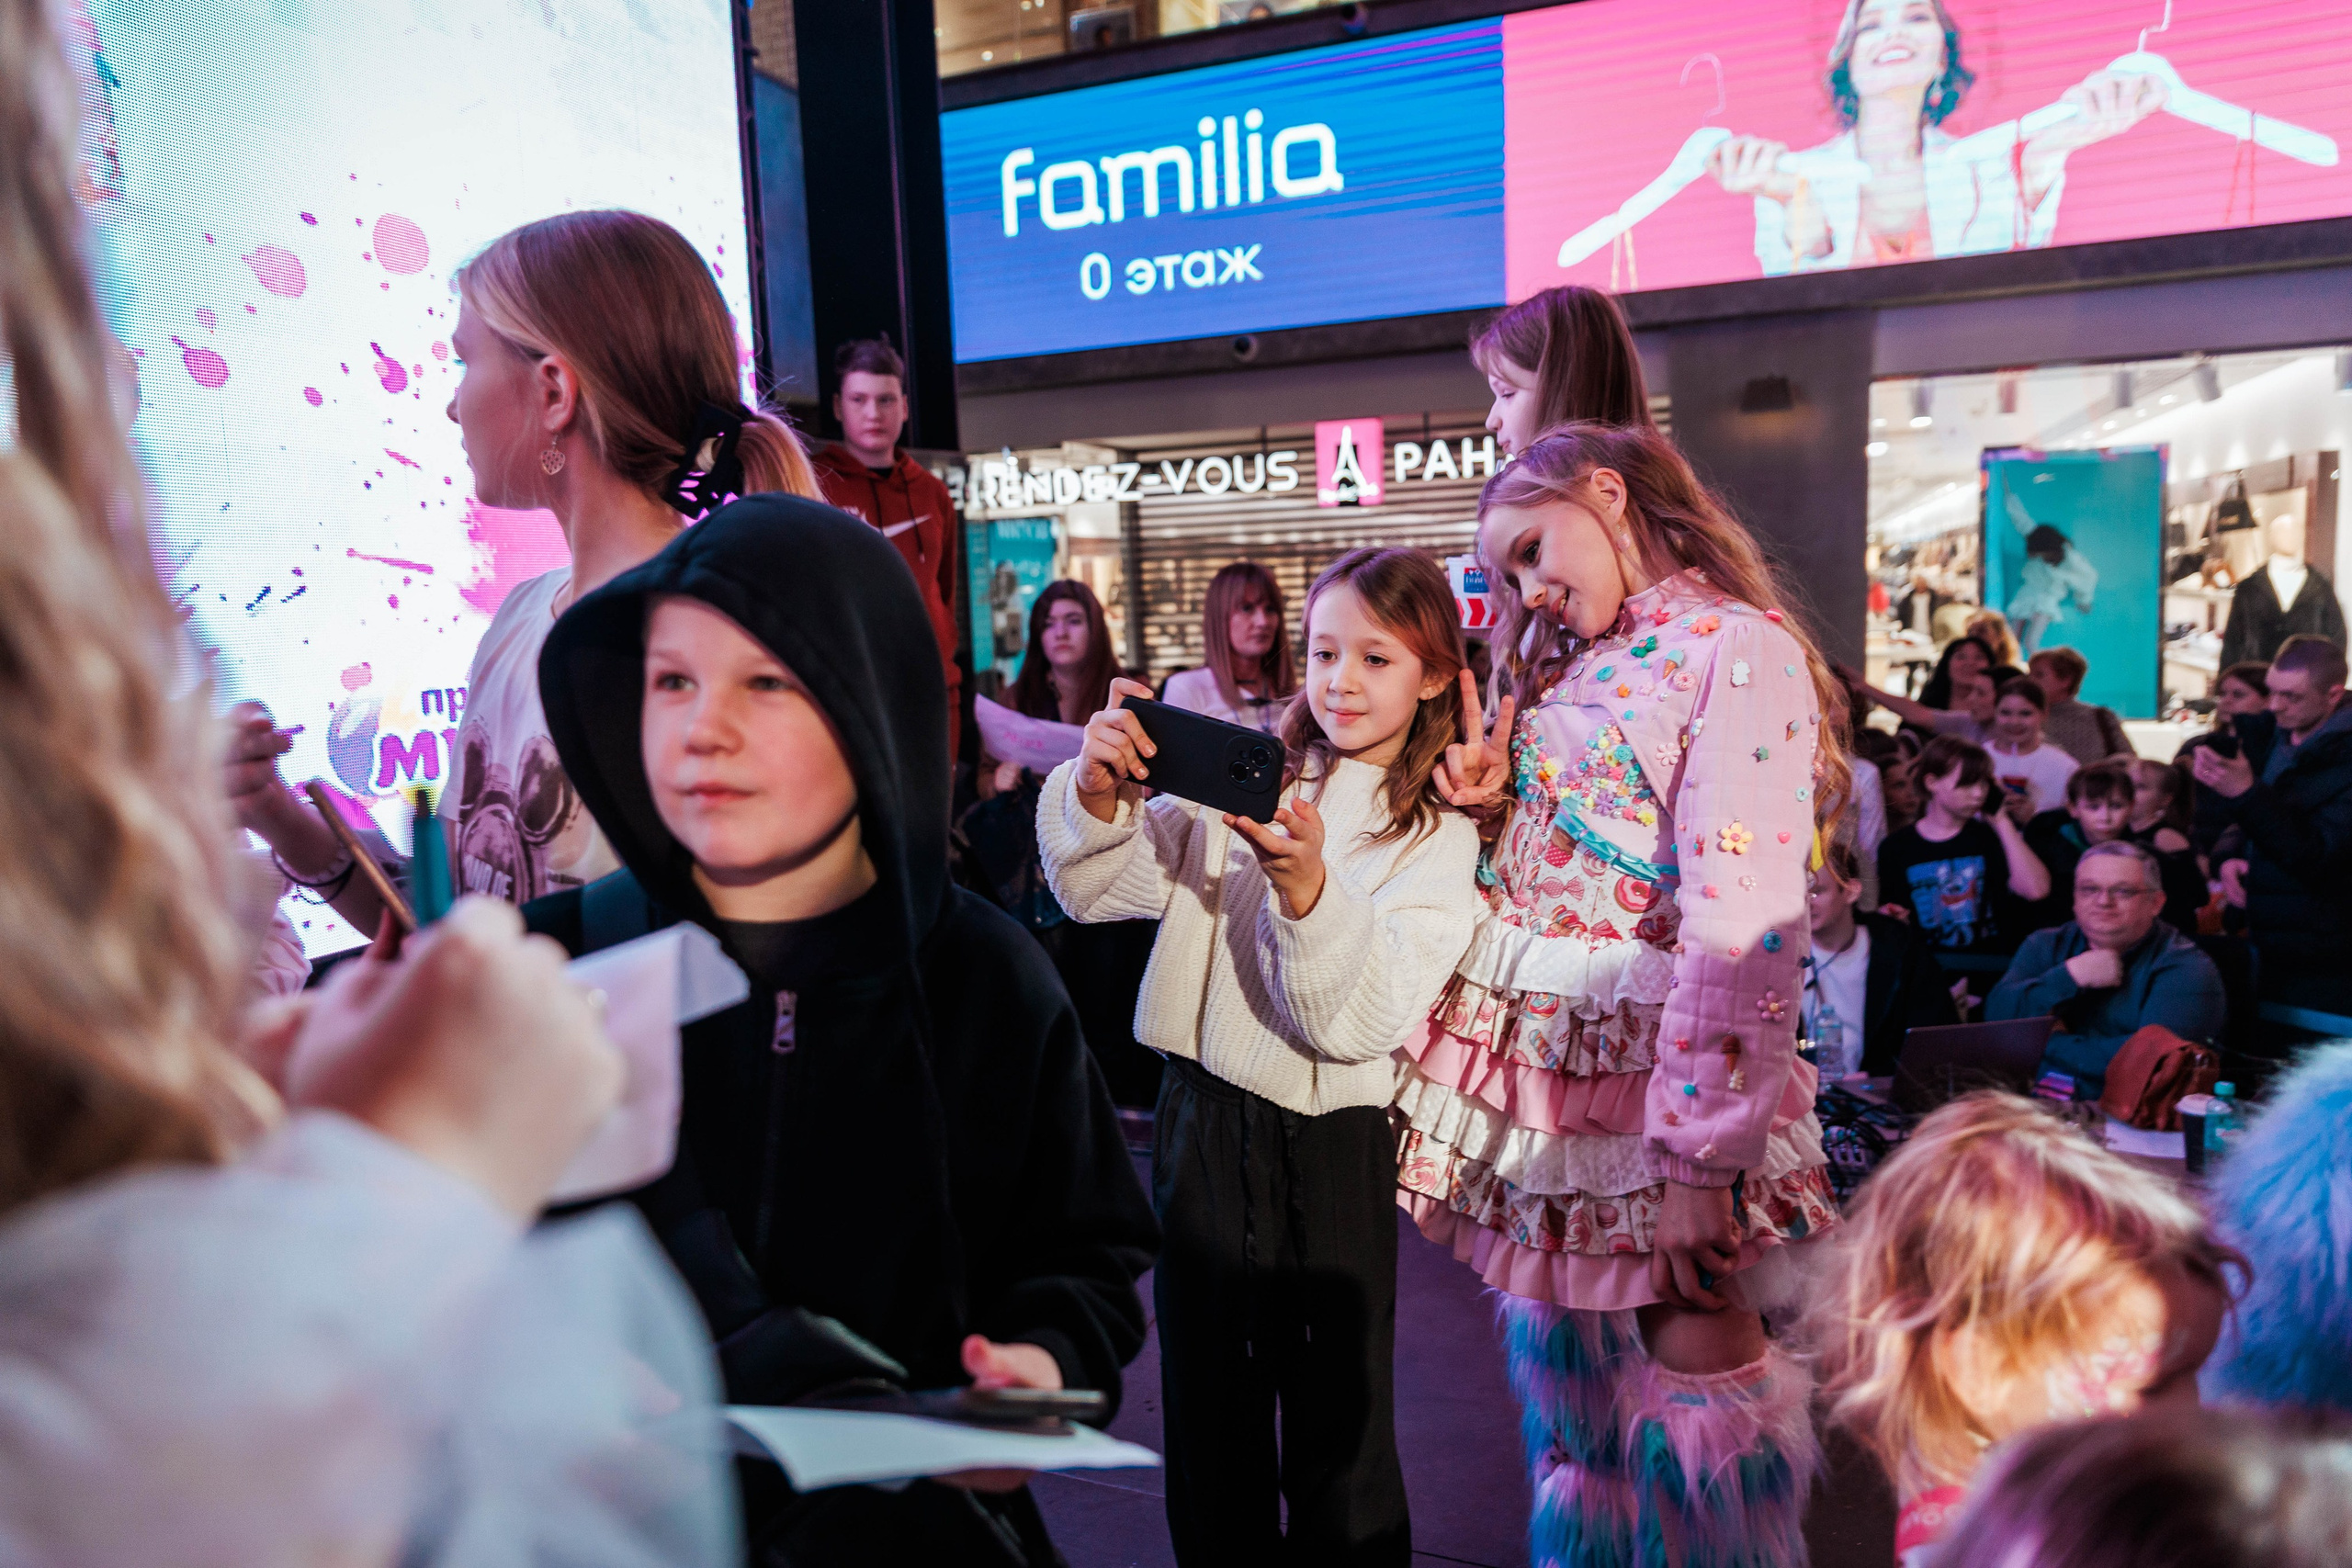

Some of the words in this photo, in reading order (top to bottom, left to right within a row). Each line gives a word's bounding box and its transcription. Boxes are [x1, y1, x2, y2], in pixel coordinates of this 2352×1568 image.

[1001, 108, 1344, 237] familia
[1080, 252, 1112, 300] 0
[1125, 243, 1264, 295] этаж
[968, 450, 1299, 510] RENDEZ-VOUS
[1393, 434, 1514, 484] РАН
[421, 687, 469, 722] пр
